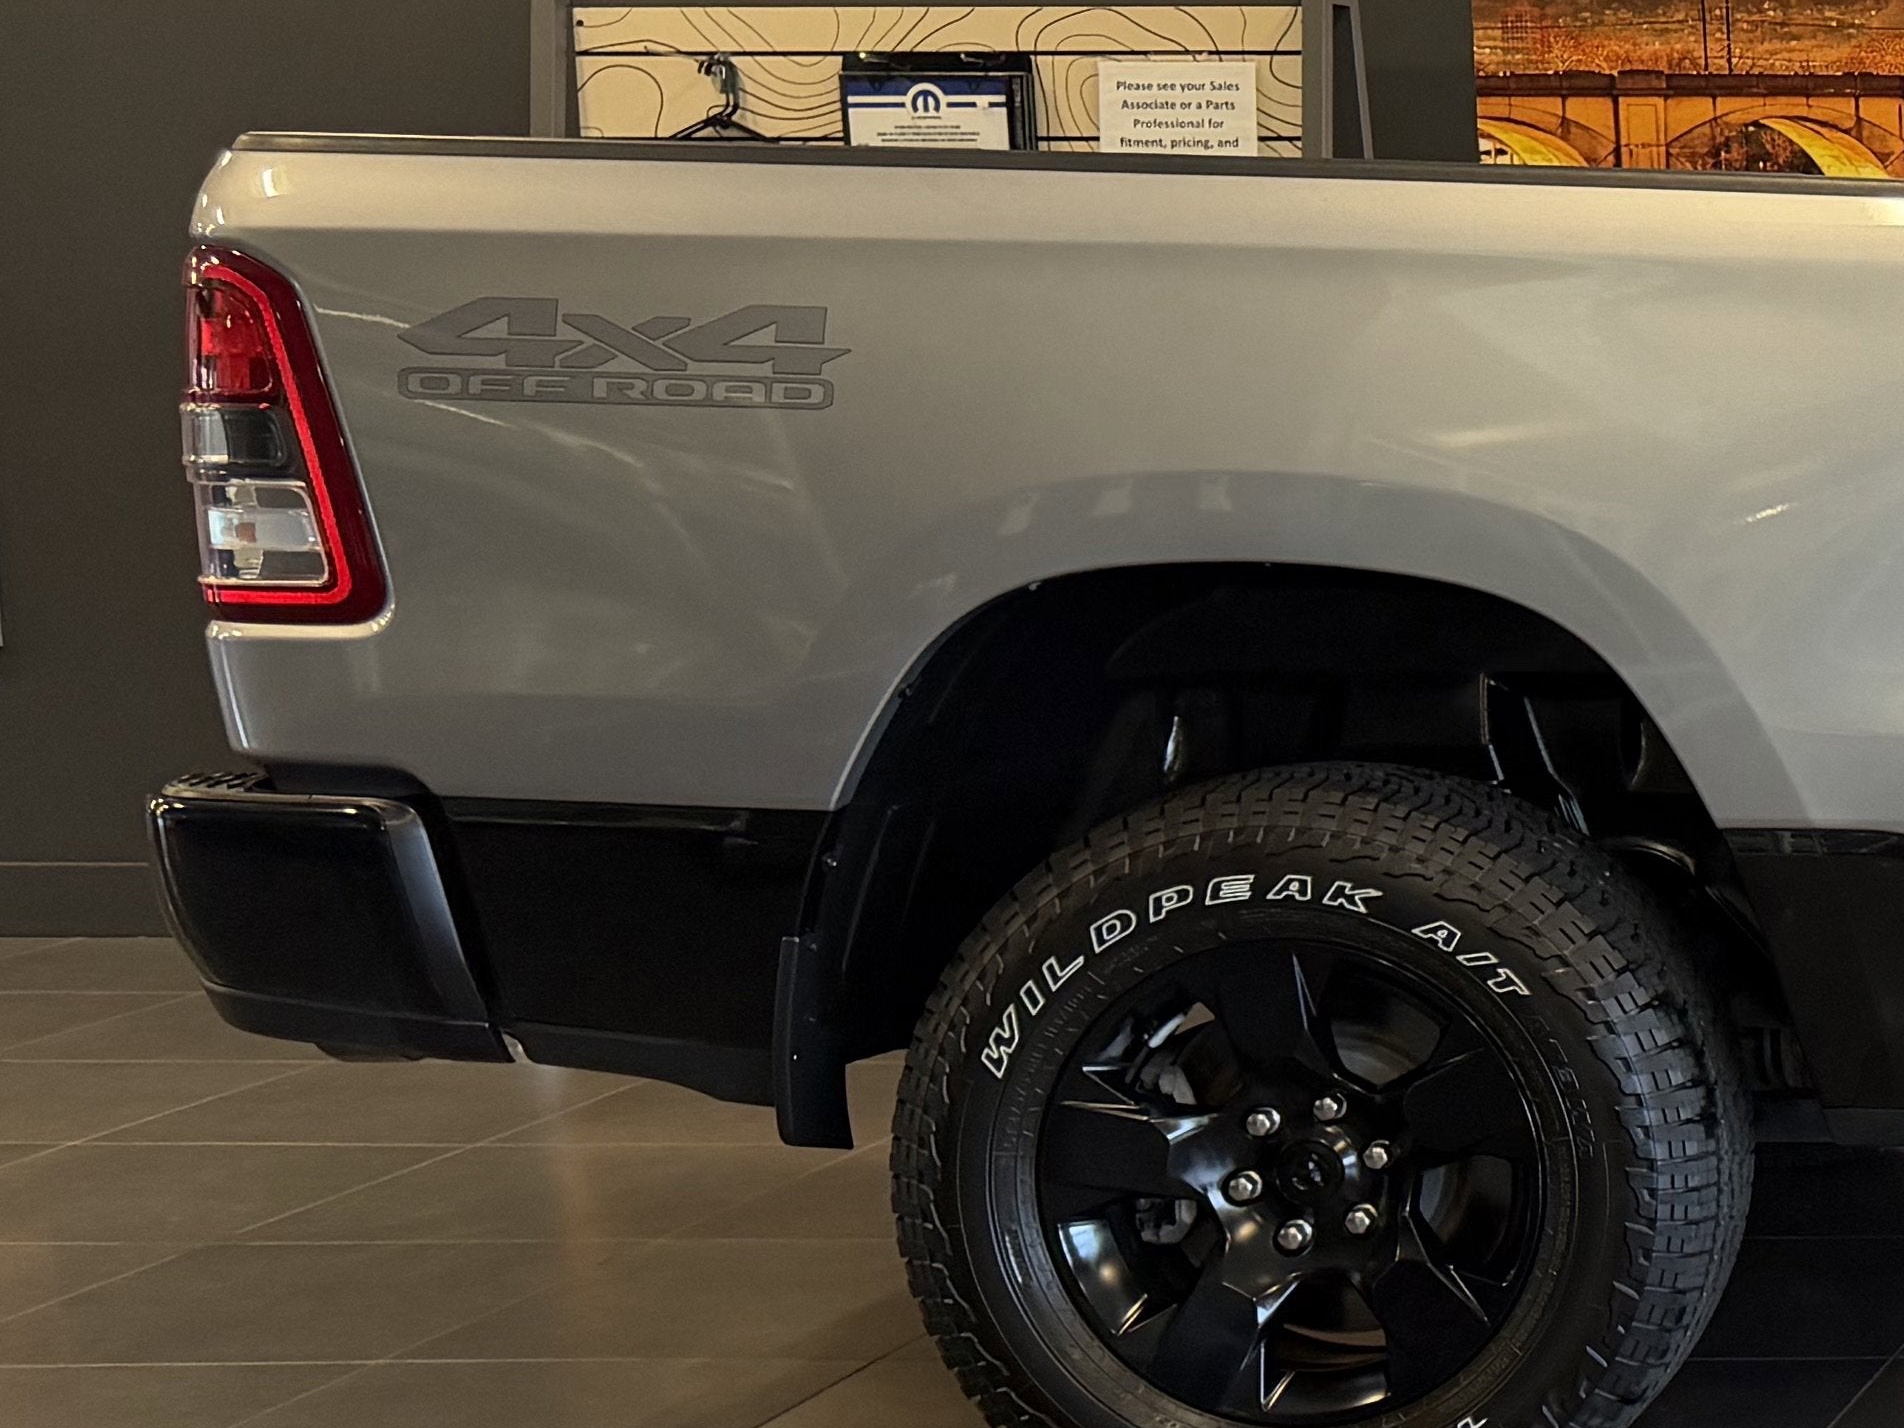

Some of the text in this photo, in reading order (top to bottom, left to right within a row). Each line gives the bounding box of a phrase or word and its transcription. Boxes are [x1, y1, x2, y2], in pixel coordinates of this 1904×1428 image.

[1116, 80, 1240, 94] Please see your Sales
[1121, 99, 1236, 111] Associate or a Parts
[1133, 118, 1225, 129] Professional for
[1120, 136, 1240, 150] fitment, pricing, and
[406, 372, 827, 405] OFF ROAD
[980, 874, 1384, 1080] WILDPEAK
